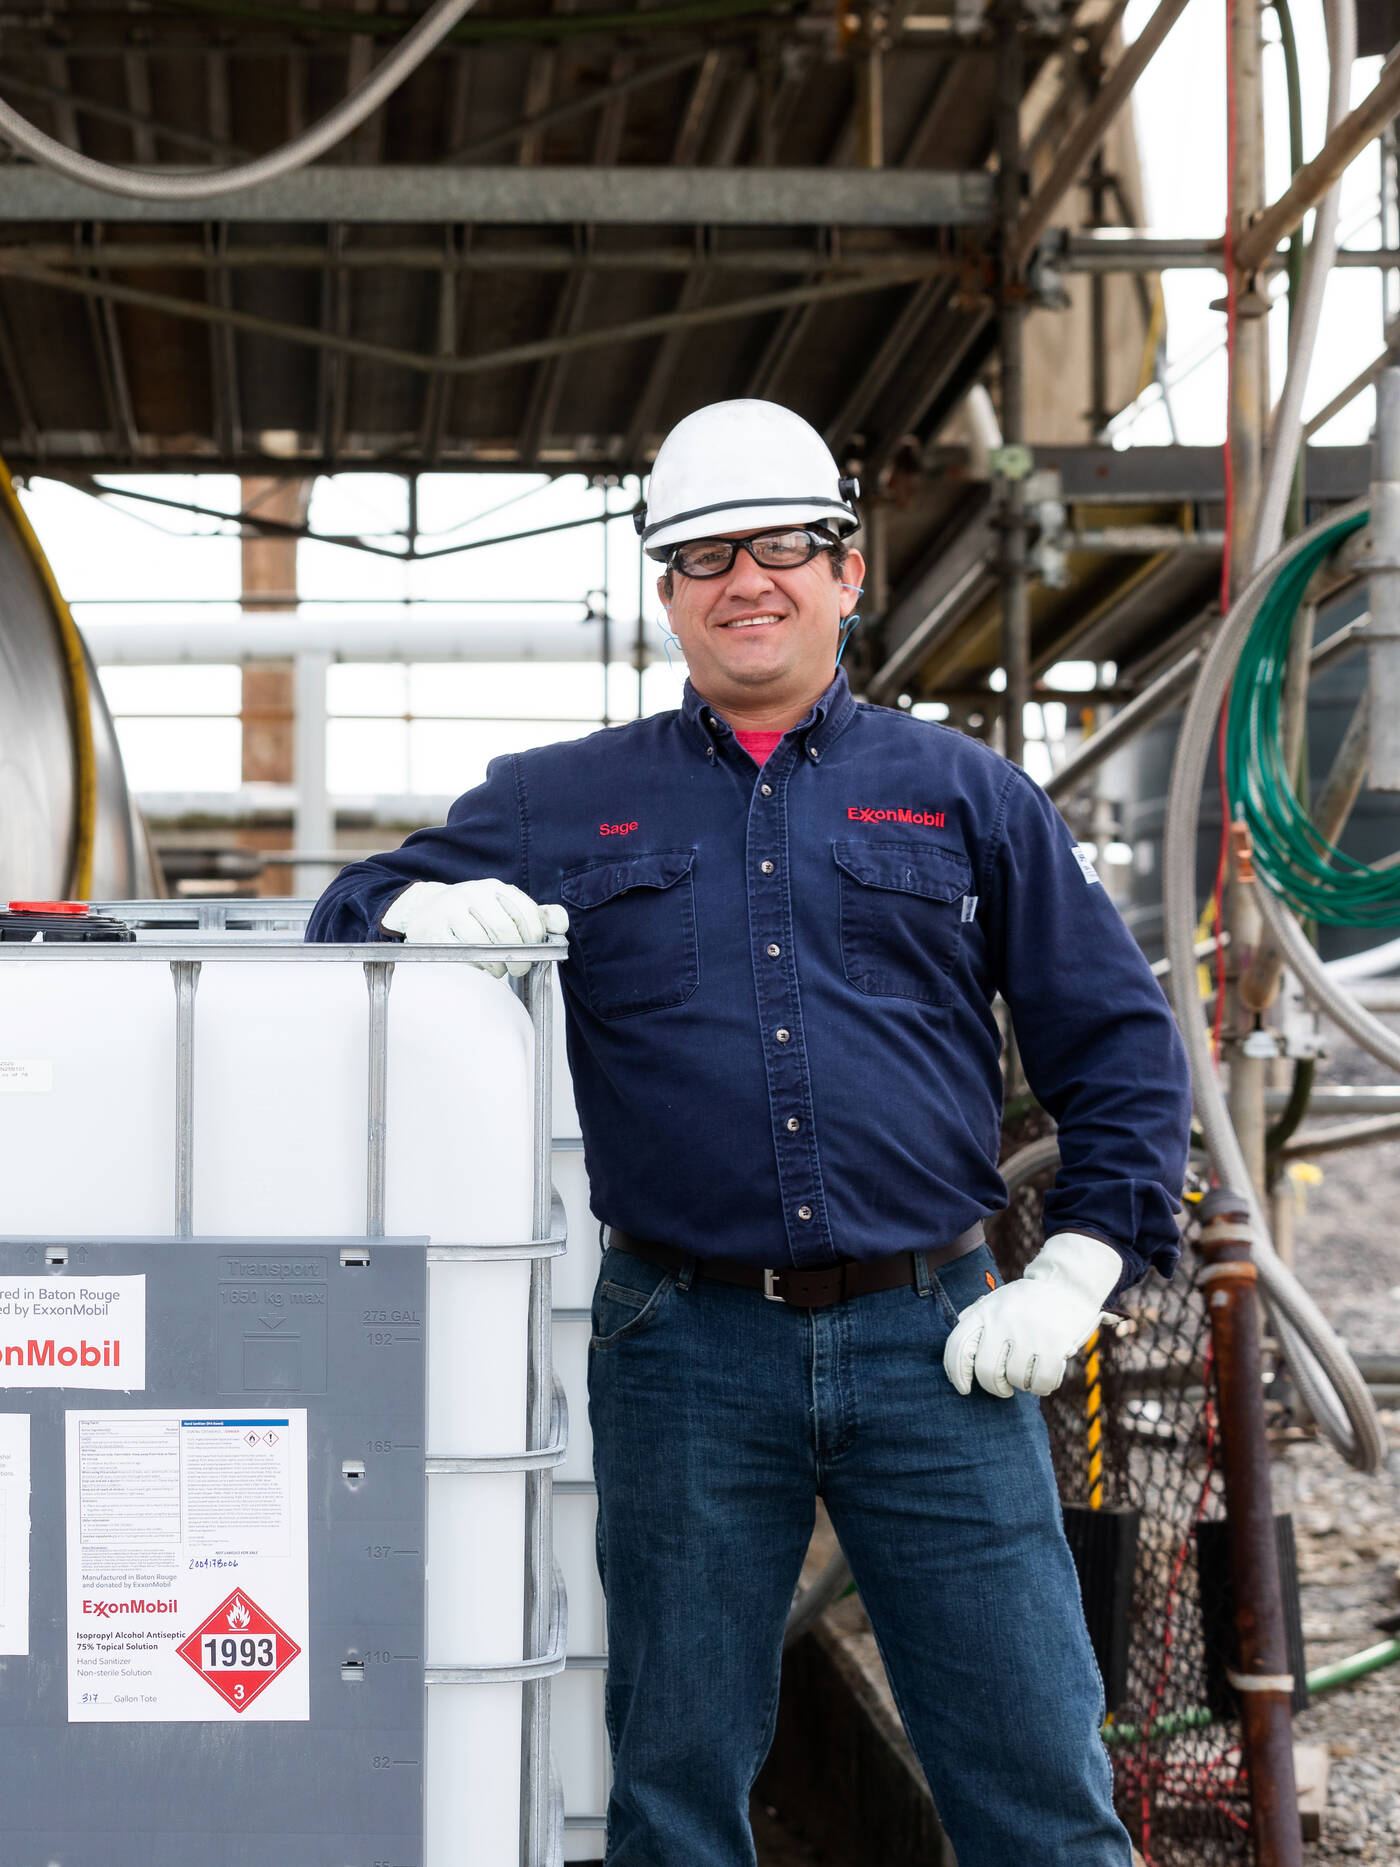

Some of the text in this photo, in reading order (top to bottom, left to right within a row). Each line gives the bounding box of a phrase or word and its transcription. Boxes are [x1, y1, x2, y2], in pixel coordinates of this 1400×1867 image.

[847, 807, 945, 828] ExxonMobil
[600, 821, 638, 836] Sage
[227, 1260, 320, 1280] Transport
[24, 1288, 34, 1300] in
[39, 1288, 75, 1300] Baton
[80, 1289, 120, 1303] Rouge
[15, 1304, 29, 1318] by
[33, 1304, 108, 1316] ExxonMobil
[364, 1311, 420, 1322] 275 GAL
[368, 1334, 392, 1345] 192
[366, 1440, 392, 1452] 165
[365, 1546, 391, 1558] 137
[83, 1600, 177, 1618] ExxonMobil
[77, 1632, 112, 1640] Isopropyl
[147, 1632, 186, 1640] Antiseptic
[96, 1643, 124, 1651] Topical
[204, 1638, 274, 1667] 1993
[365, 1651, 391, 1663] 110
[82, 1693, 98, 1703] 317
[234, 1684, 244, 1700] 3
[372, 1756, 390, 1768] 82
